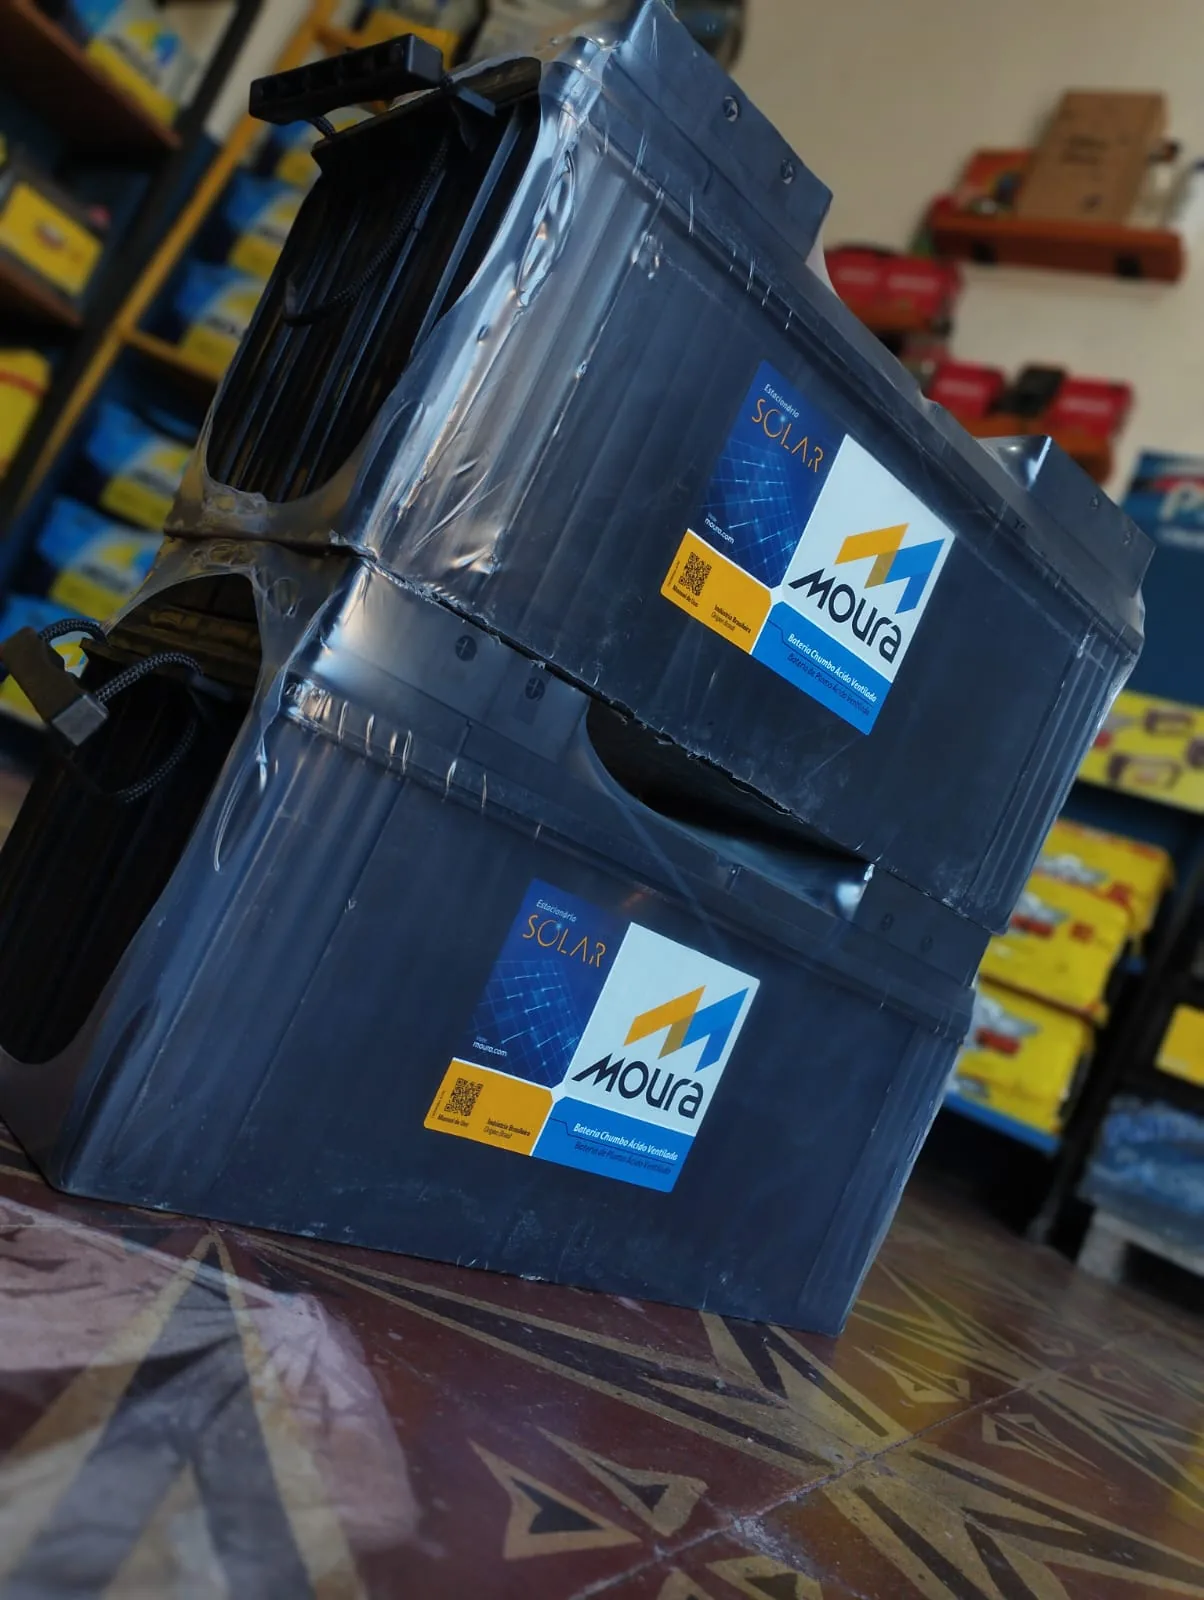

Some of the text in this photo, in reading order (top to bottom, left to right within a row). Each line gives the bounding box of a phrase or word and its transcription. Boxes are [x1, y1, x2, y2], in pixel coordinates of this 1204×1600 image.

[751, 398, 824, 473] SOLAR
[704, 517, 735, 544] moura.com
[787, 633, 811, 655] Bateria
[811, 650, 835, 672] Chumbo
[834, 666, 852, 684] Ácido
[522, 914, 606, 968] SOLAR
[472, 1041, 508, 1057] moura.com
[573, 1123, 600, 1138] Bateria
[600, 1131, 629, 1147] Chumbo
[628, 1137, 648, 1152] Ácido
